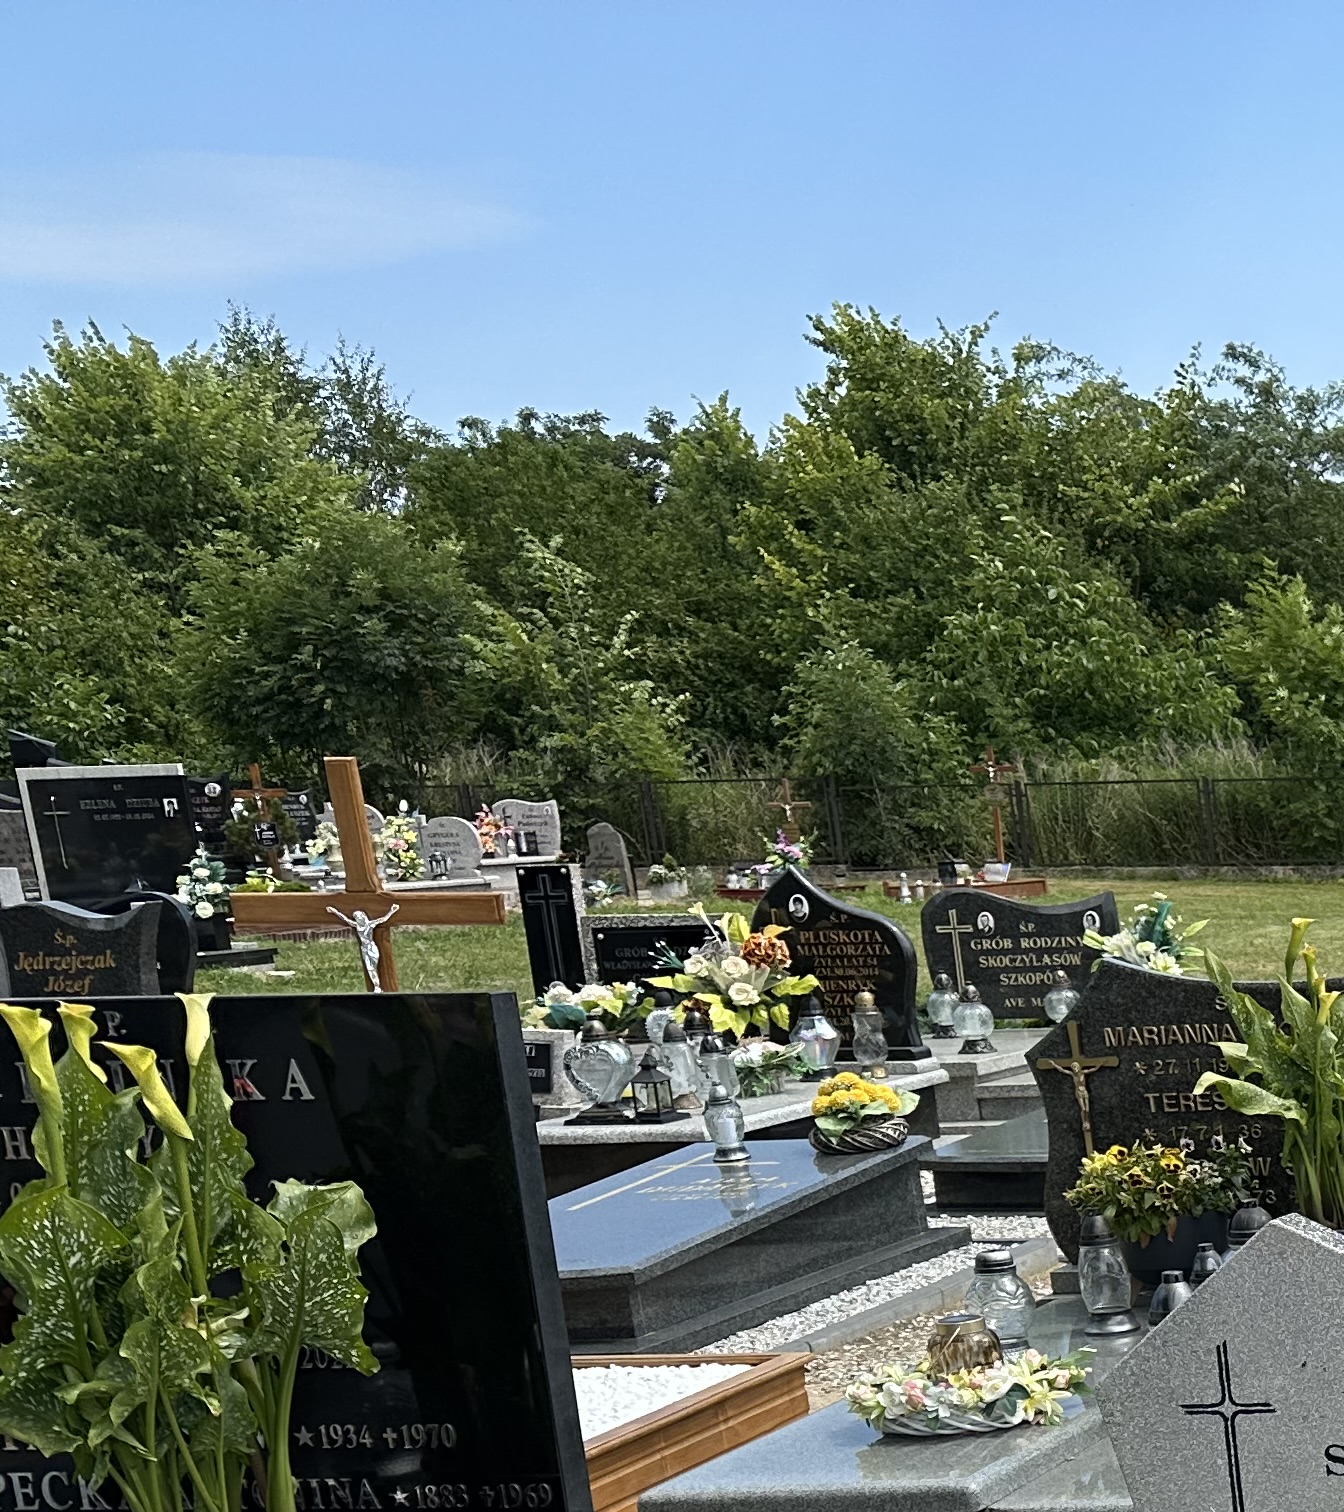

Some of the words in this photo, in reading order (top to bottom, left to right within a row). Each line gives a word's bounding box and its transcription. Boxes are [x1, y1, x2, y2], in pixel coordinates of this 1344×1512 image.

[970, 935, 1014, 950] GRÓB
[14, 949, 117, 975] Jędrzejczak
[44, 975, 94, 996] Józef
[999, 969, 1054, 986] SZKOPÓ
[1103, 1023, 1238, 1048] MARIANNA
[1143, 1091, 1229, 1114] TERES
